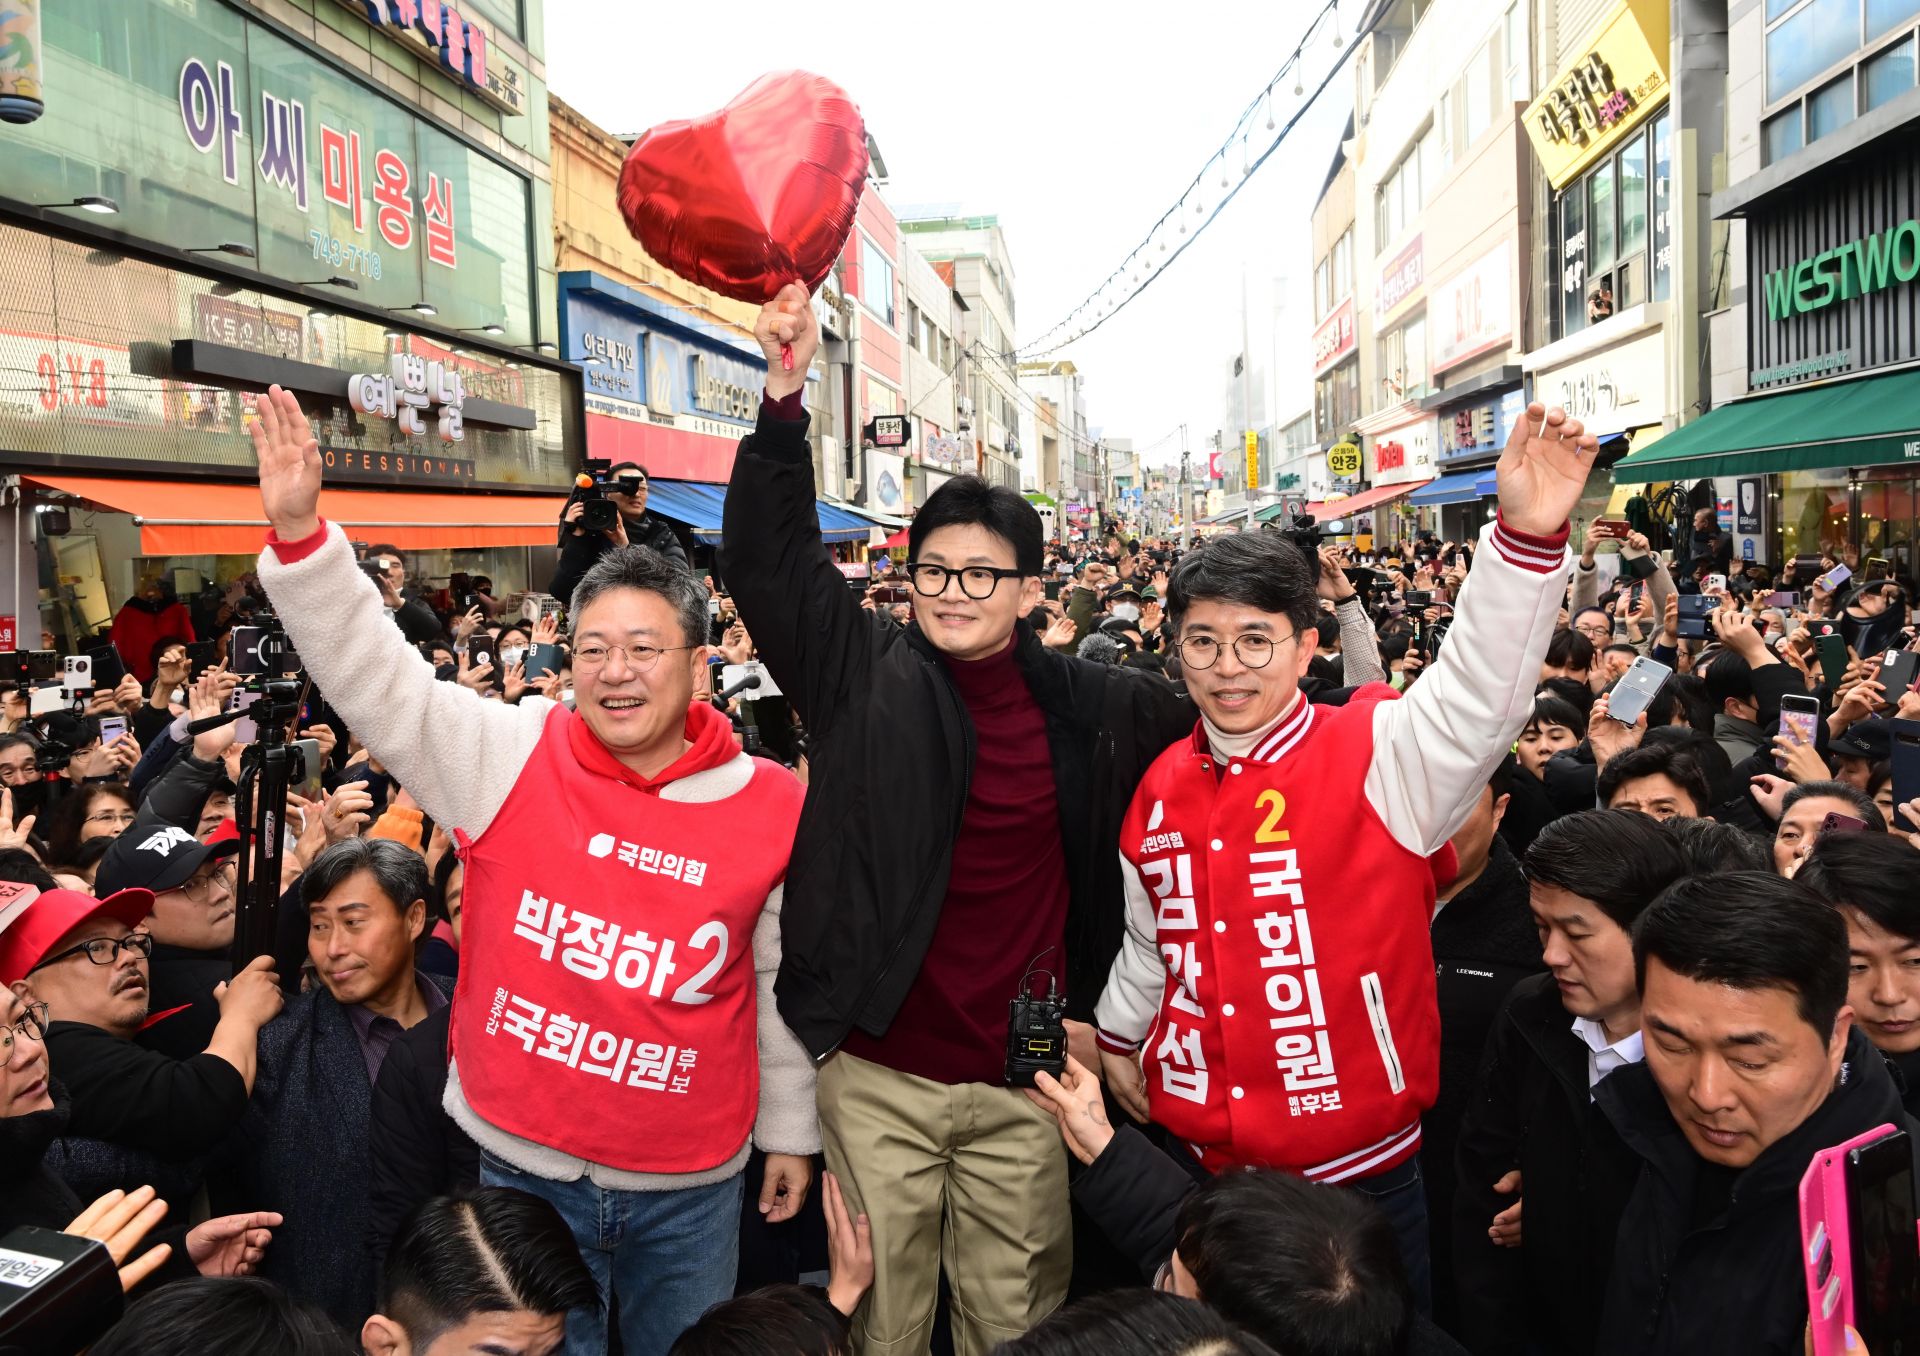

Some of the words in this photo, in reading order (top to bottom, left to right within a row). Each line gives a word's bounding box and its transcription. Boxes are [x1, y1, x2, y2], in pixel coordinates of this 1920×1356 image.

[309, 229, 382, 281] 743-7118
[349, 353, 466, 441] 예쁜날
[878, 421, 901, 434] 부동산
[325, 450, 473, 477] OFESSIONAL
[1332, 455, 1357, 471] 안경
[1254, 788, 1290, 844] 2
[617, 840, 708, 888] 국민의힘
[513, 888, 677, 998] 박정하
[671, 919, 730, 1006] 2
[1249, 847, 1339, 1093] 국회의원
[1456, 968, 1494, 978] LEEWONJAE
[485, 986, 509, 1036] 원주갑
[502, 993, 679, 1092] 국회의원
[667, 1046, 699, 1094] 후보
